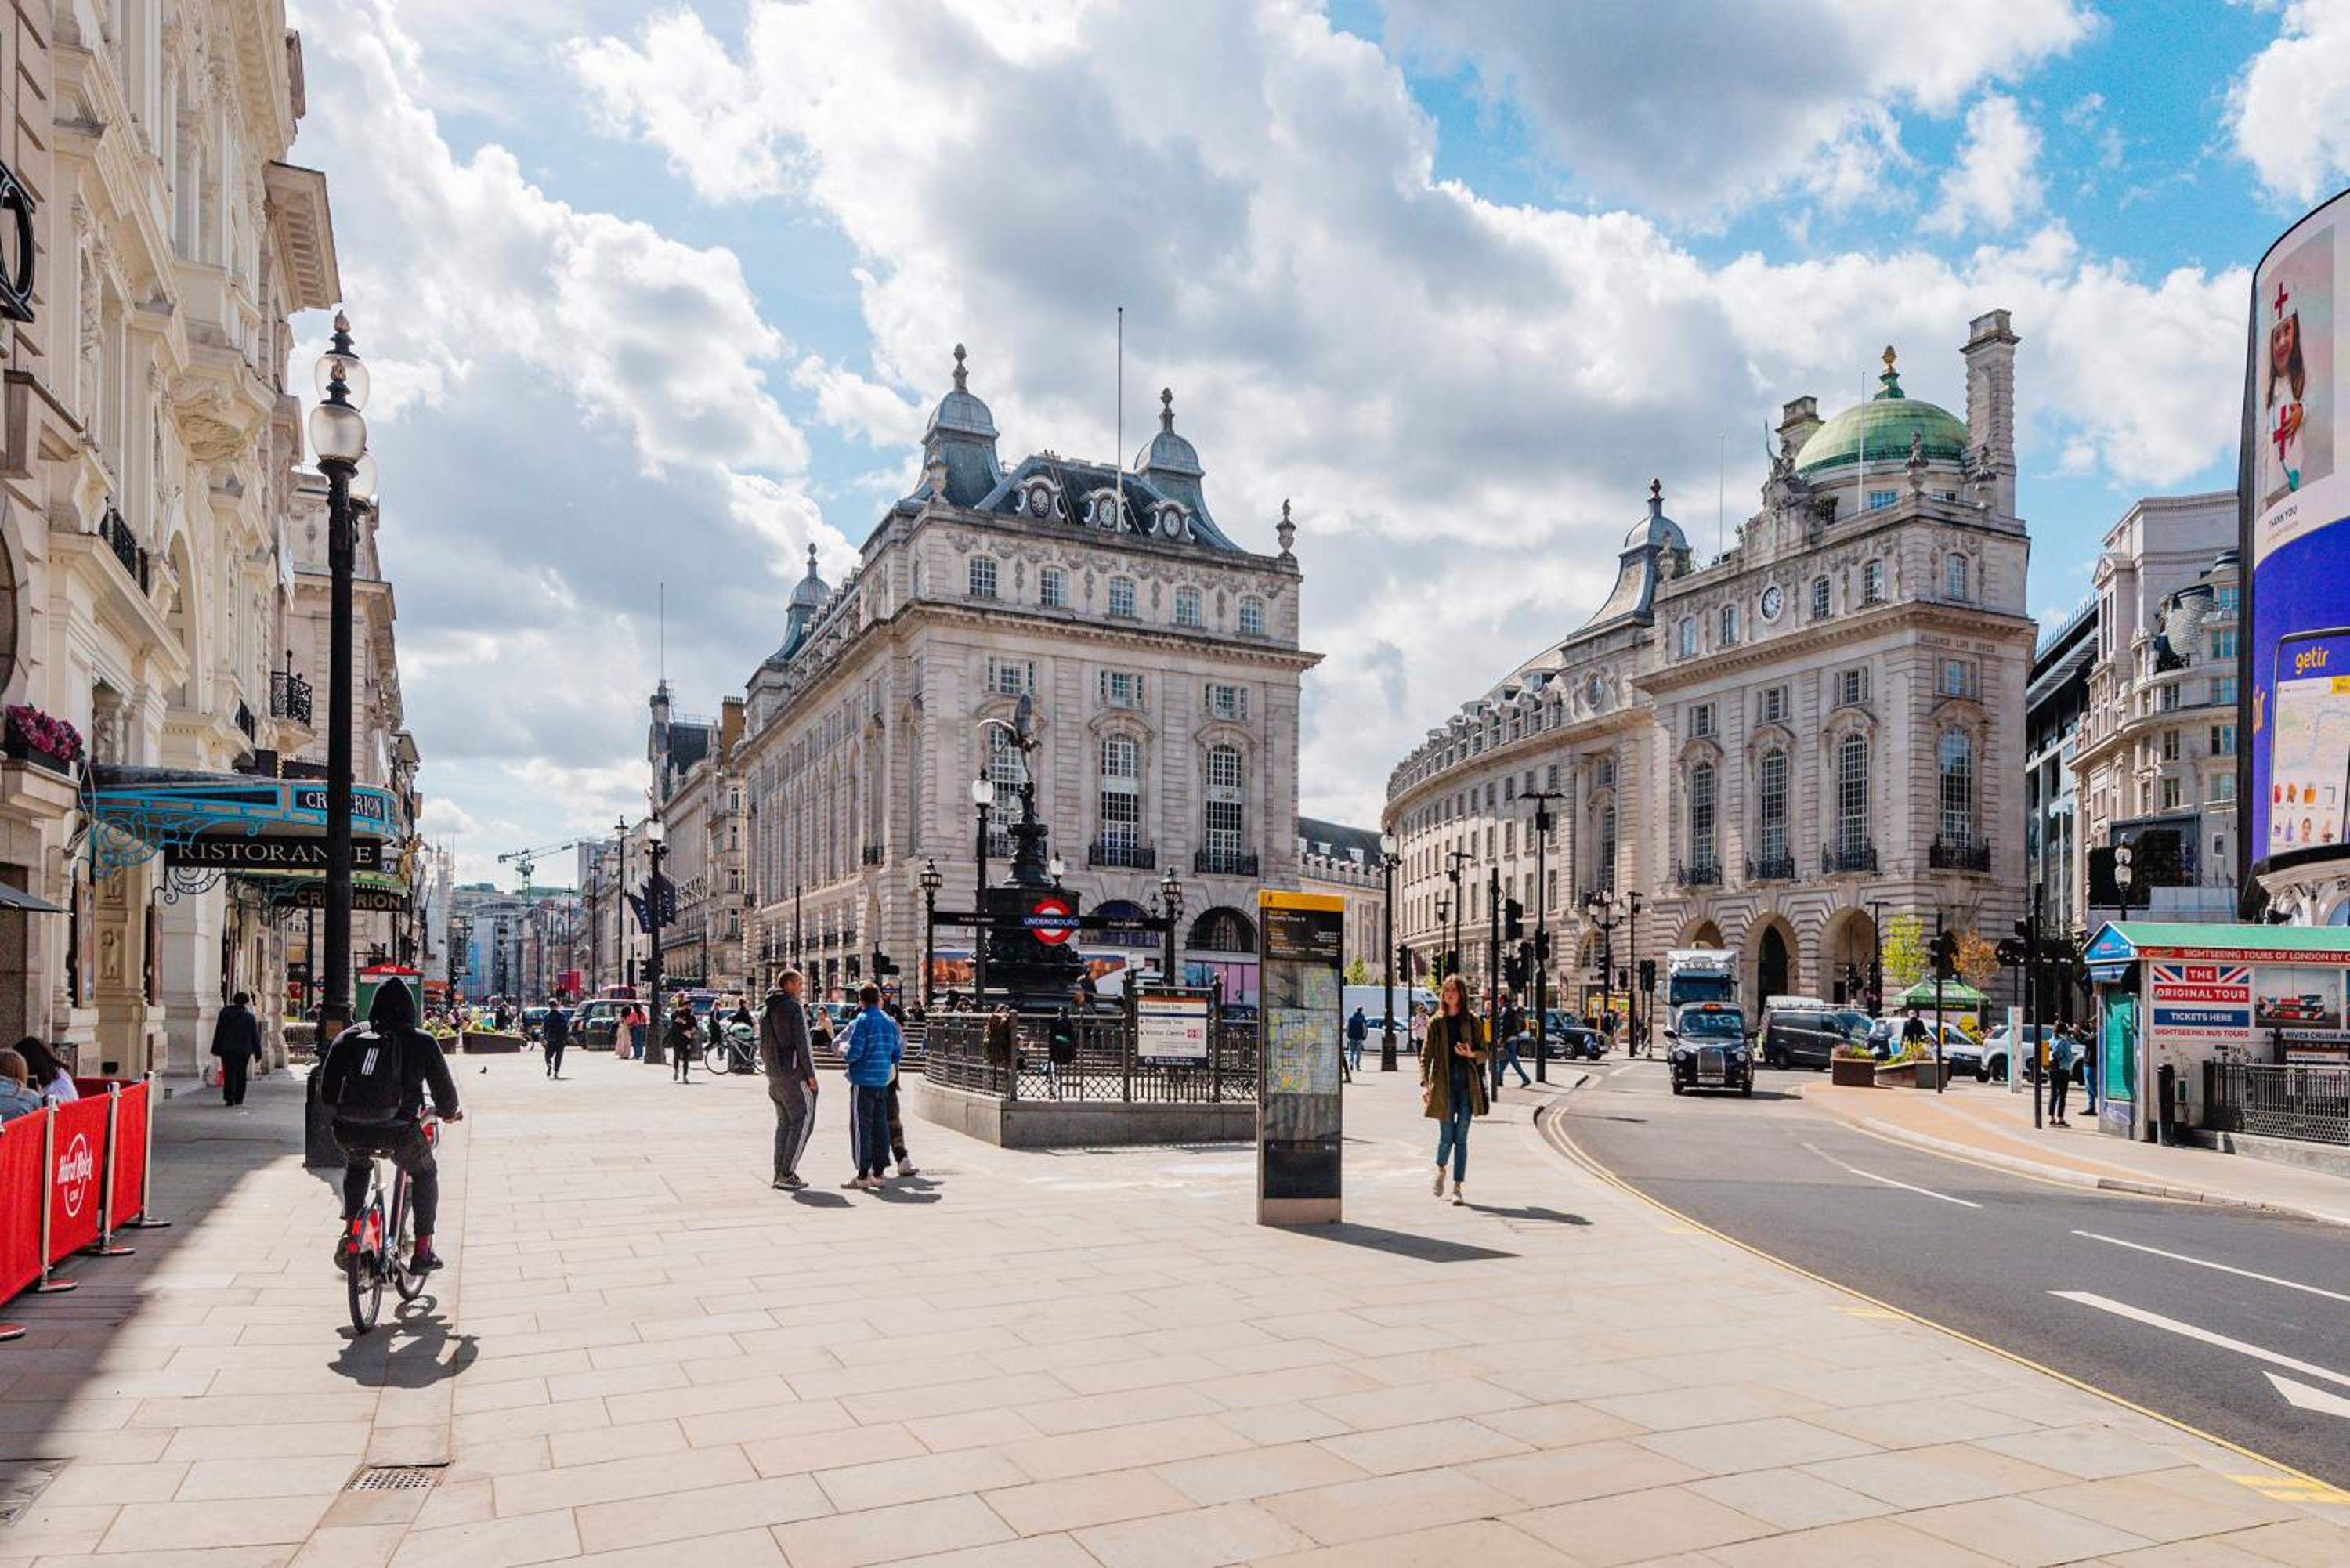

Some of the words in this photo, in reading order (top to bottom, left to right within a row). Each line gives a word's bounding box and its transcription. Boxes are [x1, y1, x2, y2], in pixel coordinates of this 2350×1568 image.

[2295, 646, 2330, 674] getir
[306, 792, 381, 818] CRRION
[176, 842, 372, 864] RISTORANE
[297, 891, 401, 909] CRRION
[1024, 917, 1080, 927] UNDERGROUND
[2183, 949, 2241, 959] SIGHTSEEING
[2244, 951, 2272, 960] TOURS
[2275, 952, 2286, 960] OF
[2290, 952, 2329, 961] LONDON
[2331, 952, 2343, 961] BY
[2189, 970, 2213, 980] THE
[2157, 988, 2212, 999] ORIGINAL
[2214, 989, 2247, 999] TOUR
[2171, 1012, 2207, 1021] TICKETS
[2209, 1013, 2232, 1022] HERE
[2223, 1030, 2249, 1039] TOURS
[2310, 1031, 2338, 1039] CRUISE
[57, 1153, 78, 1184] Hard
[77, 1148, 93, 1184] Rock
